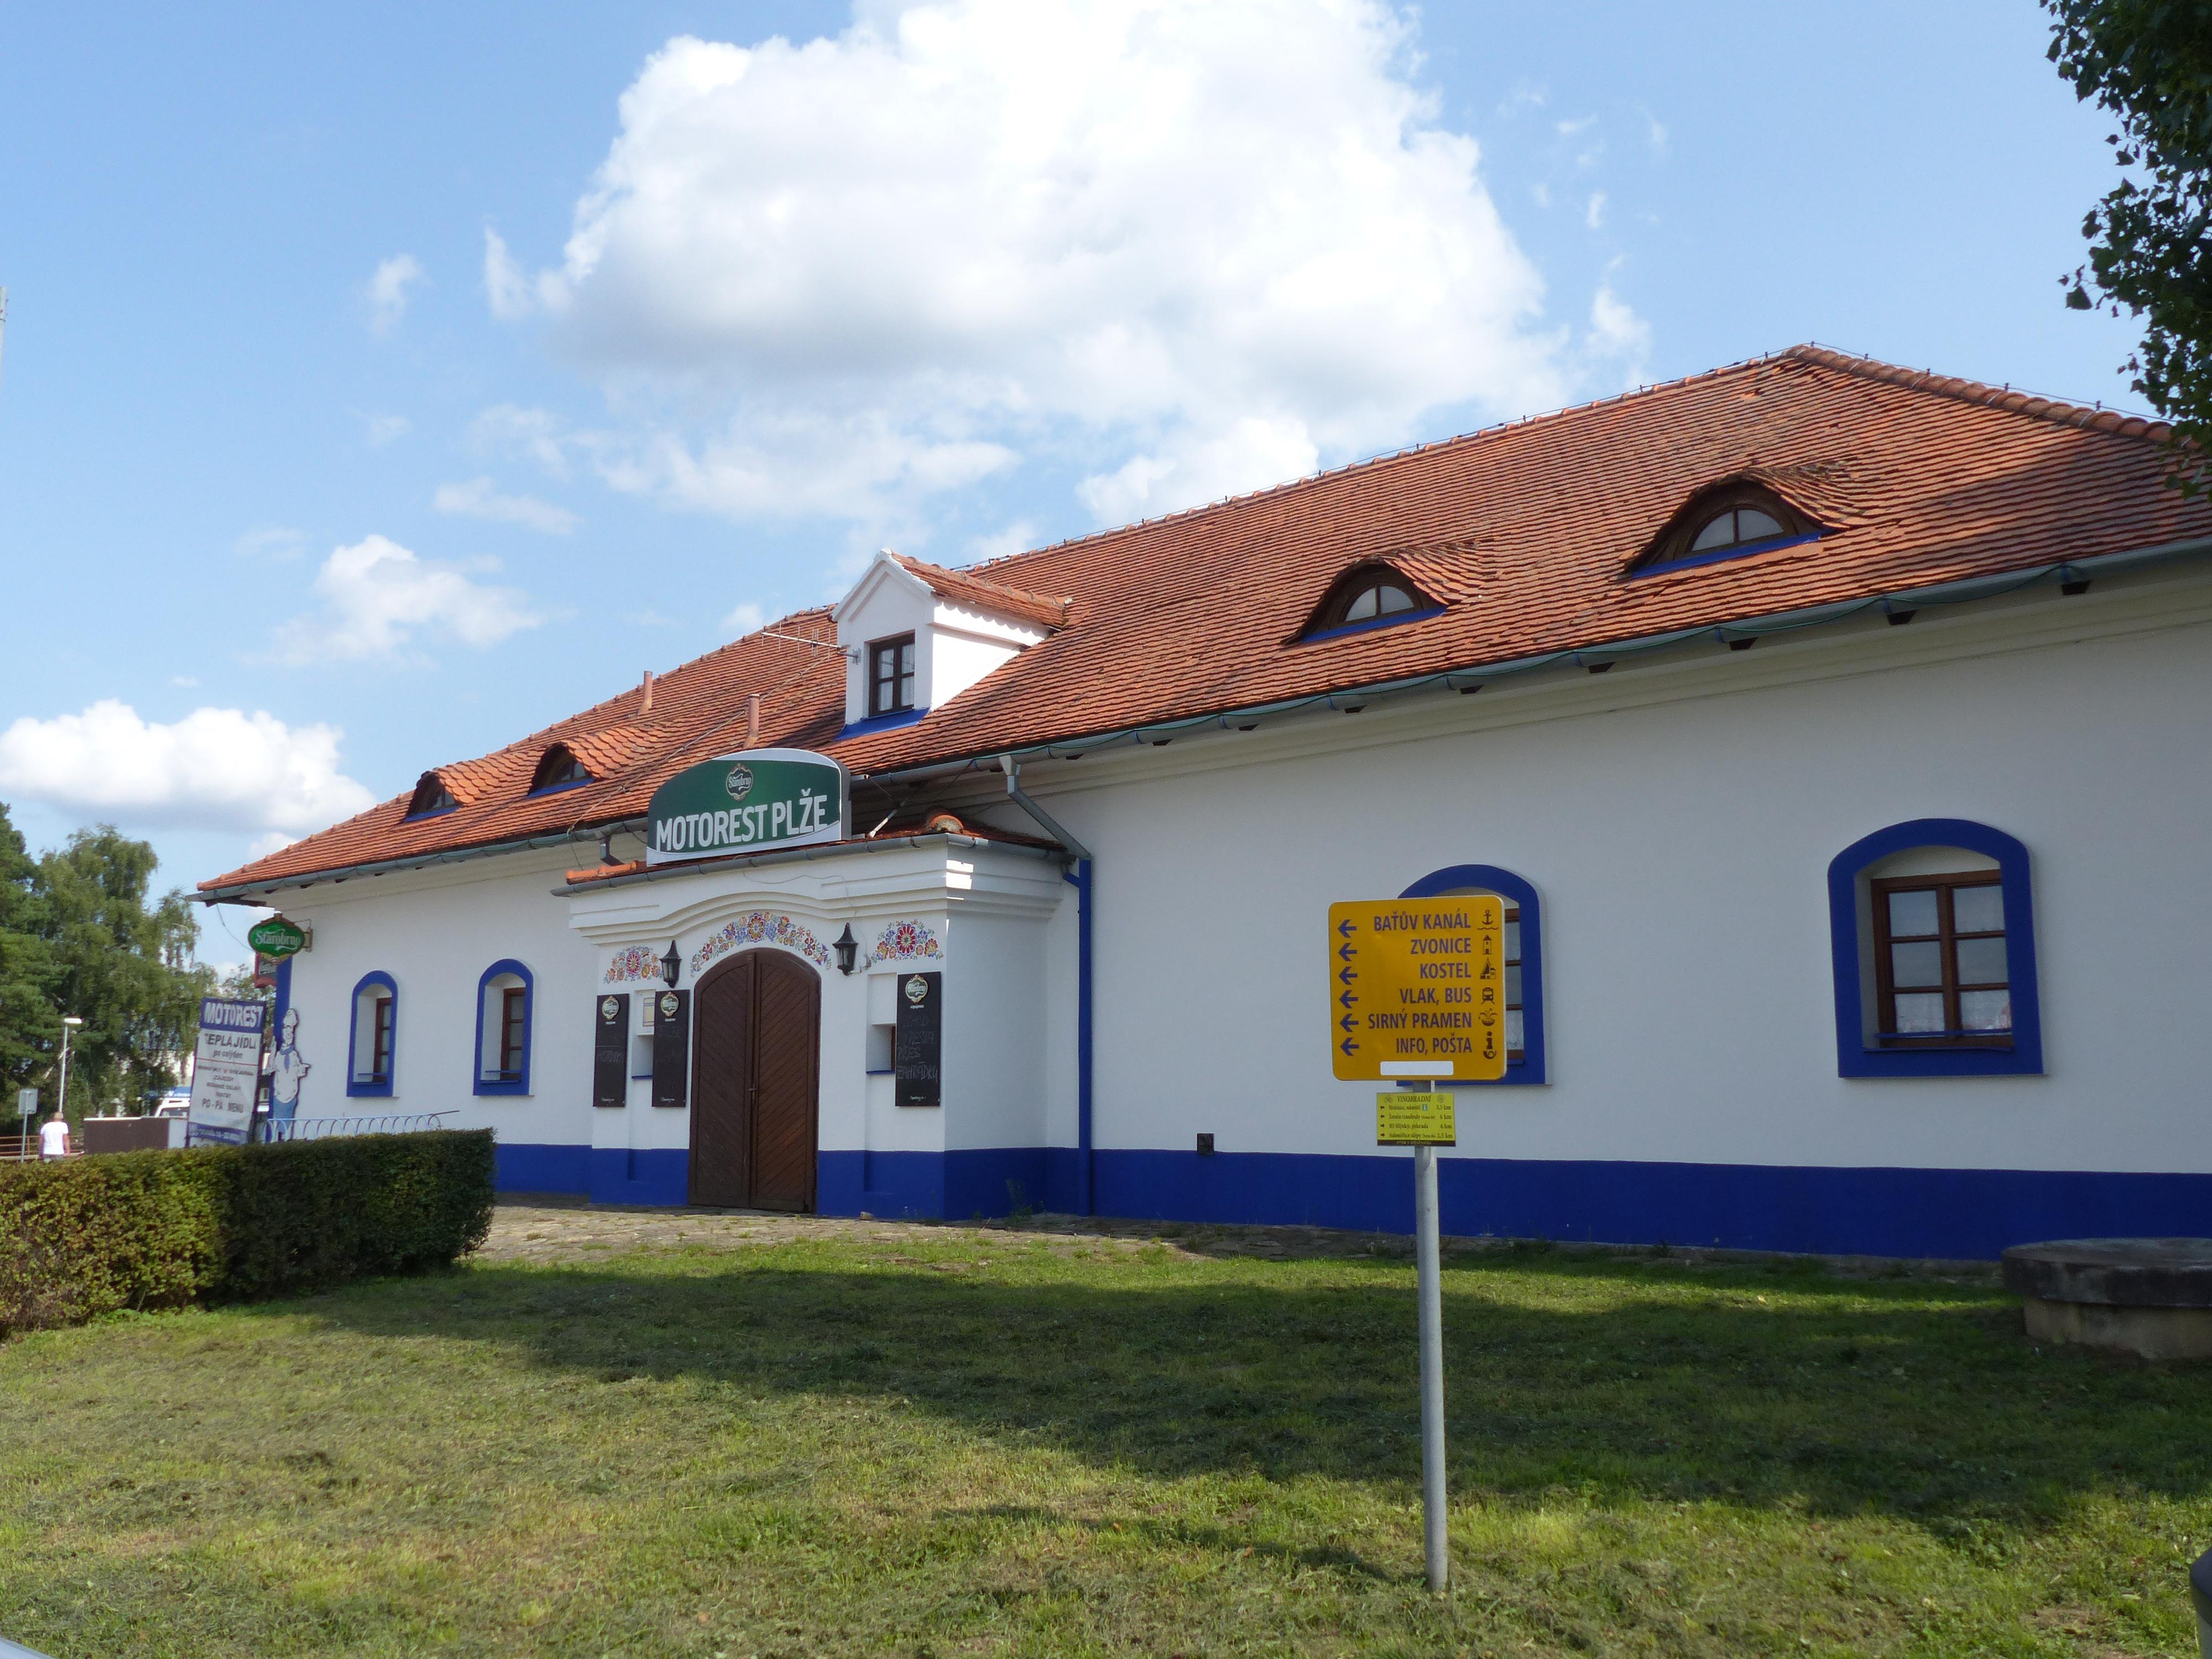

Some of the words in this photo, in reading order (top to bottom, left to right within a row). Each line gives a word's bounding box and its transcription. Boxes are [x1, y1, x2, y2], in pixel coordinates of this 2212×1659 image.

[656, 804, 768, 851] MOTOREST
[773, 788, 828, 837] PLŽE
[1374, 911, 1418, 931] BAŤŮV
[1423, 908, 1471, 929] KANÁL
[1411, 937, 1471, 954] ZVONICE
[1420, 963, 1472, 979] KOSTEL
[1400, 988, 1439, 1005] VLAK,
[1445, 987, 1472, 1003] BUS
[204, 1002, 264, 1027] MOTOREST
[1368, 1009, 1408, 1029] SIRNÝ
[1412, 1012, 1472, 1029] PRAMEN
[1396, 1037, 1428, 1055] INFO,
[1433, 1032, 1473, 1053] POŠTA
